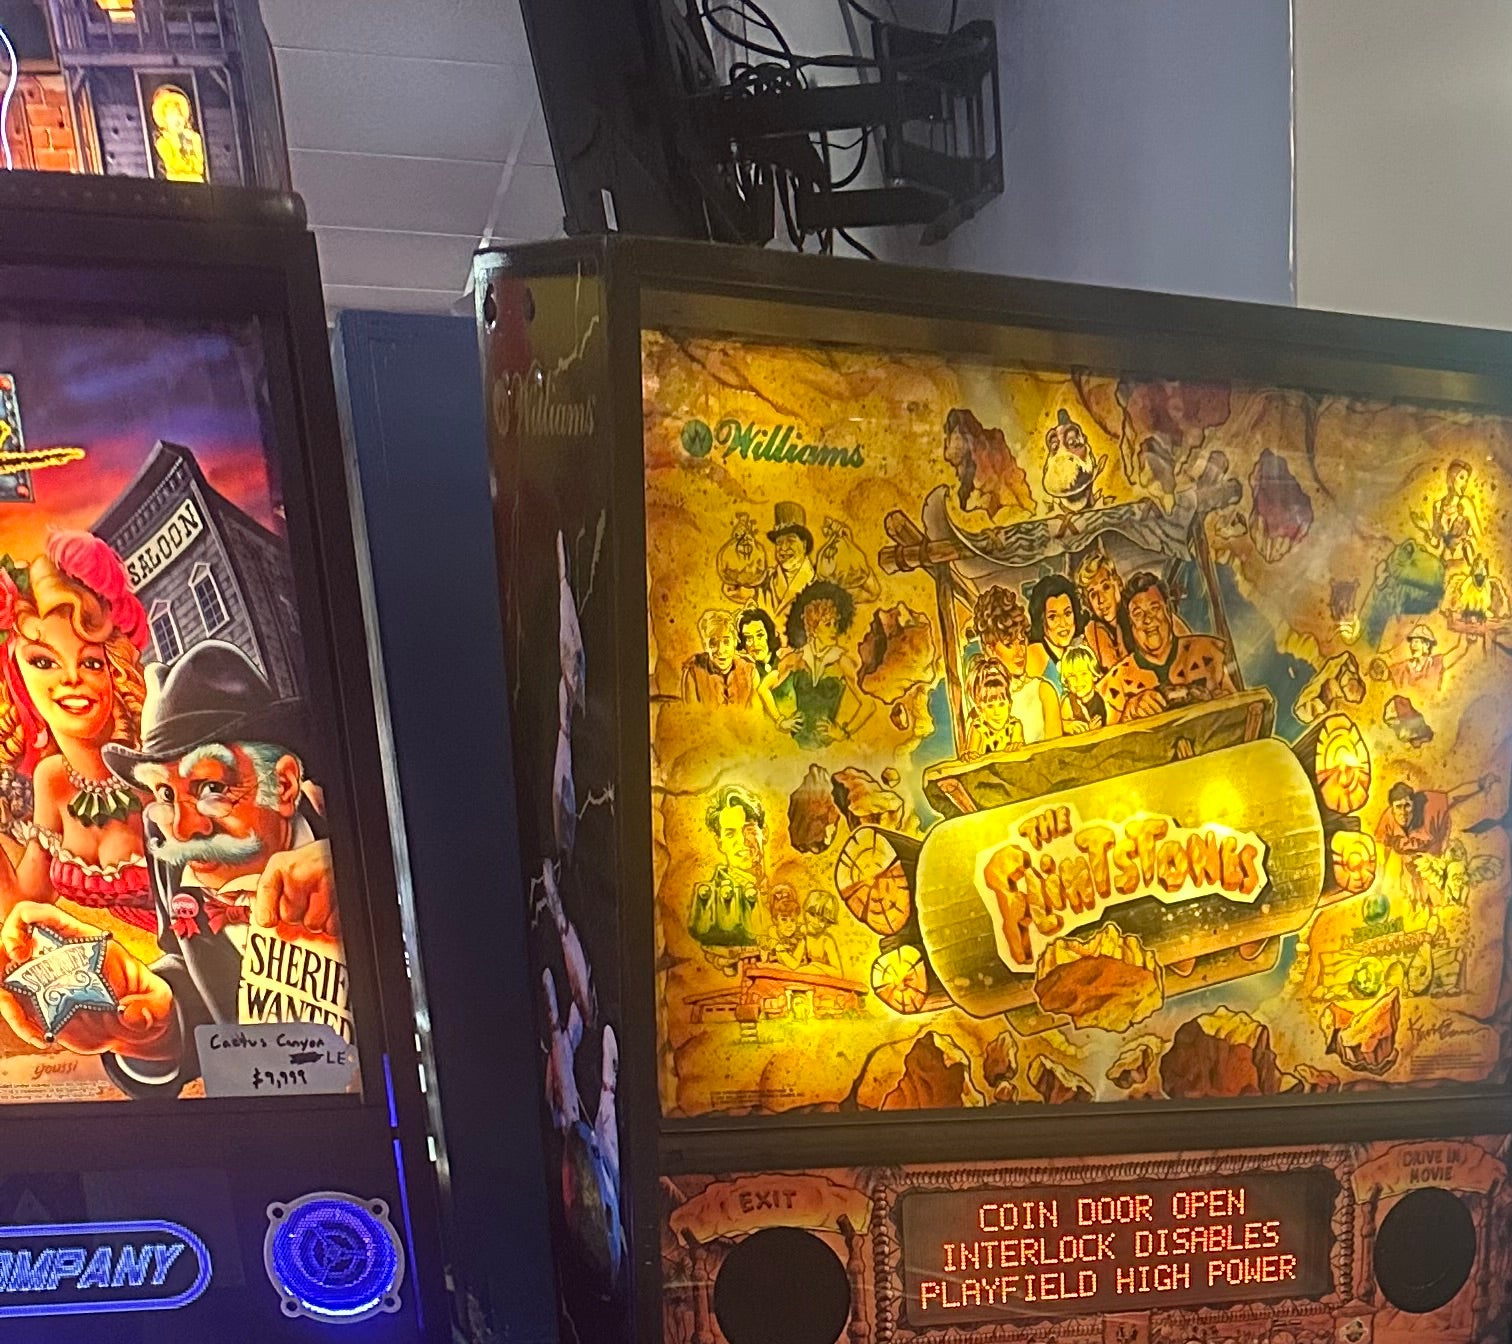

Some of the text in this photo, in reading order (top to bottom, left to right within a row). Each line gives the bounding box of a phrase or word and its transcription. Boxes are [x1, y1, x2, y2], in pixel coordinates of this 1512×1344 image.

[716, 418, 865, 468] Williams
[127, 503, 199, 587] SALOON
[1018, 805, 1073, 850] THE
[210, 1033, 325, 1051] Cactus Canyon
[252, 1067, 308, 1090] $9,999
[1410, 1165, 1454, 1183] MOVIE
[740, 1188, 797, 1213] EXIT
[978, 1187, 1246, 1232] COIN DOOR OPEN
[0, 1243, 186, 1293] MPANY
[942, 1220, 1281, 1273] INTERLOCK DISABLES
[920, 1253, 1298, 1311] PLAYFIELD HIGH POWER
